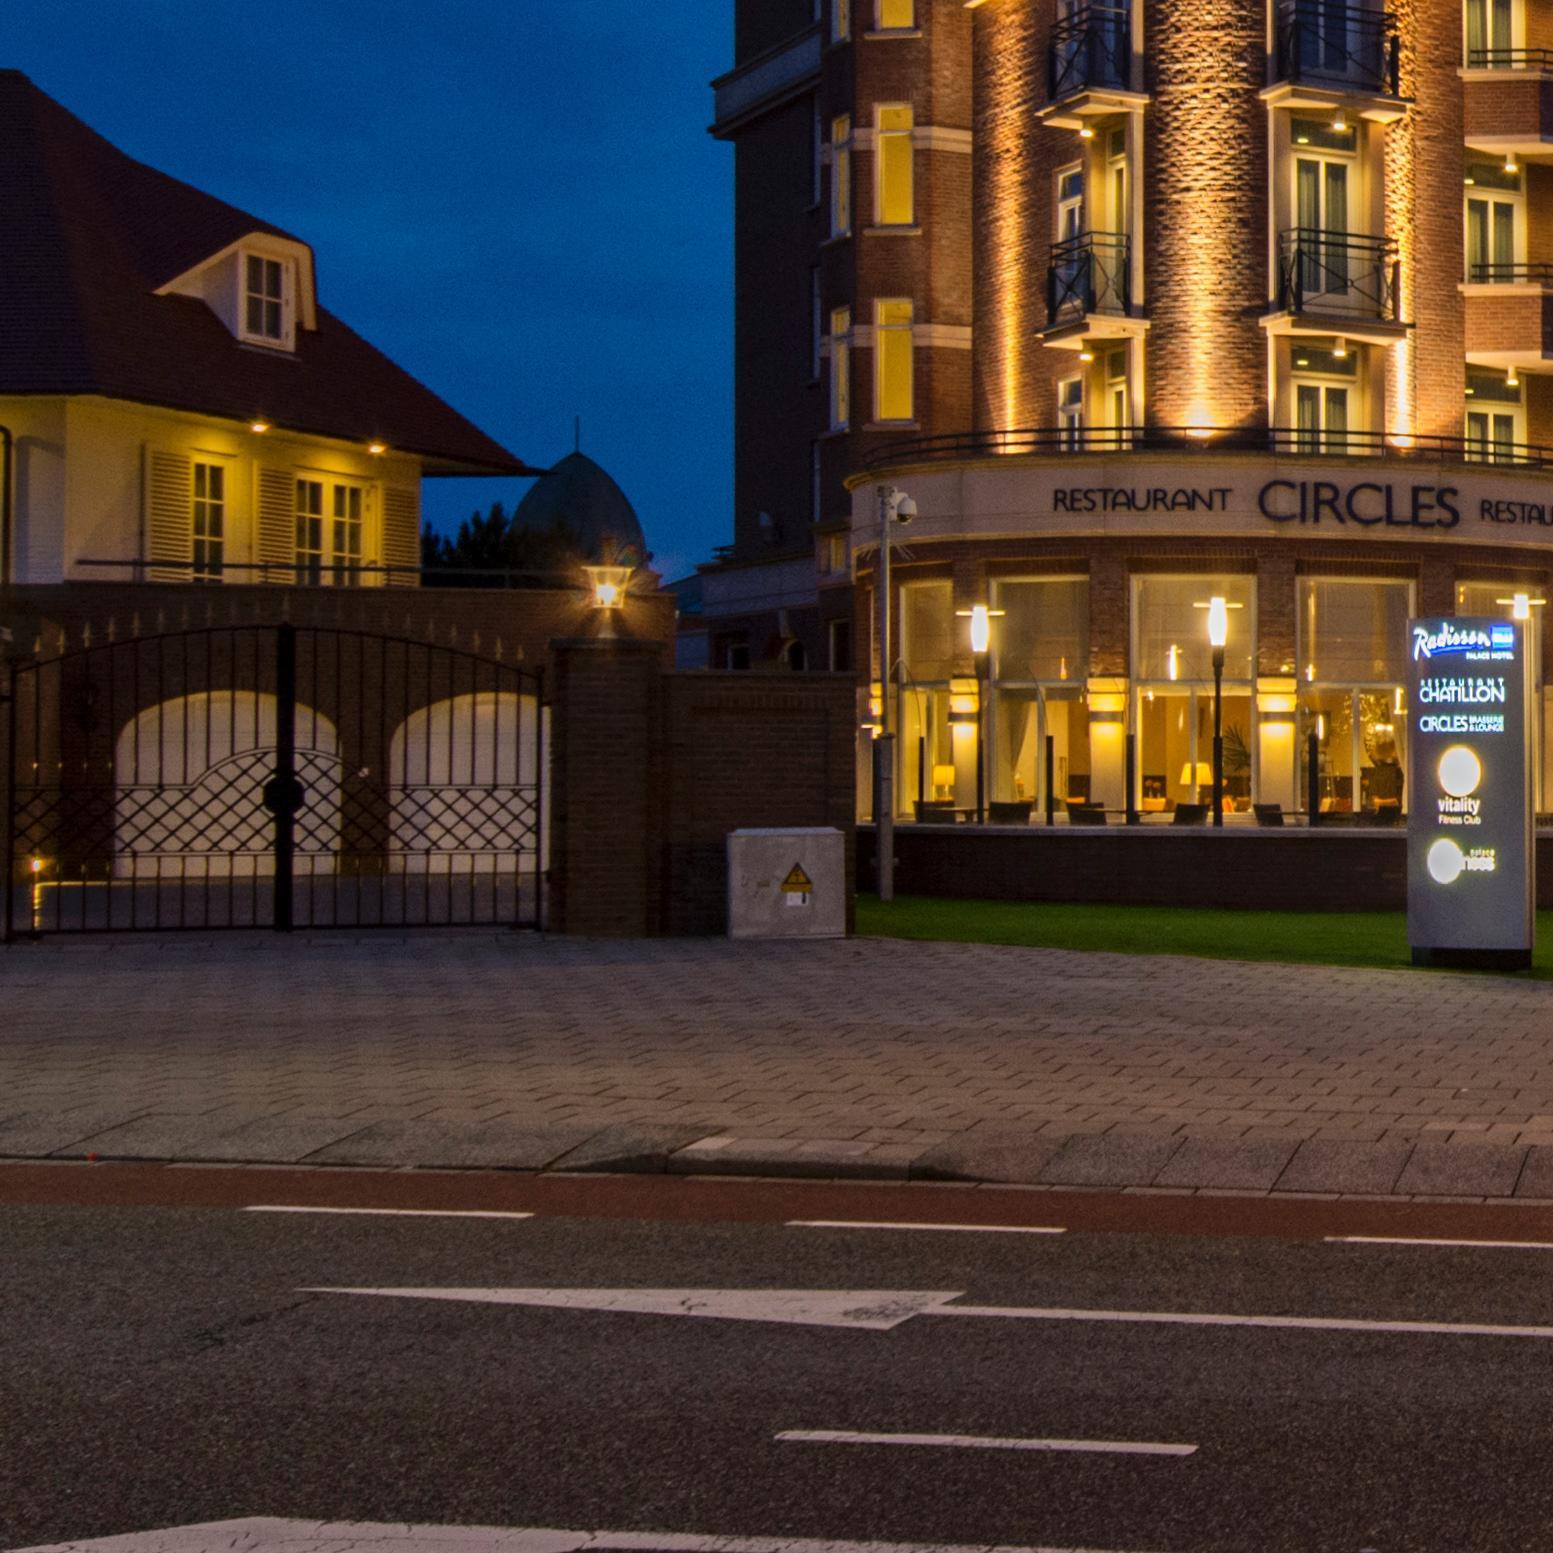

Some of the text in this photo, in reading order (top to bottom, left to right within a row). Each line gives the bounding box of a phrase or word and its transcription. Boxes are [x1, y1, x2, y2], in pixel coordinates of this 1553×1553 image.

[1052, 486, 1234, 513] RESTAURANT
[1257, 479, 1461, 529] CIRCLES
[1412, 621, 1491, 662] Radisson
[1419, 678, 1505, 688] RESTAURANT
[1419, 686, 1506, 703] CHATILLON
[1419, 715, 1468, 733] CIRCLES
[1437, 796, 1481, 816] vitality
[1438, 814, 1482, 825] Fitness Club
